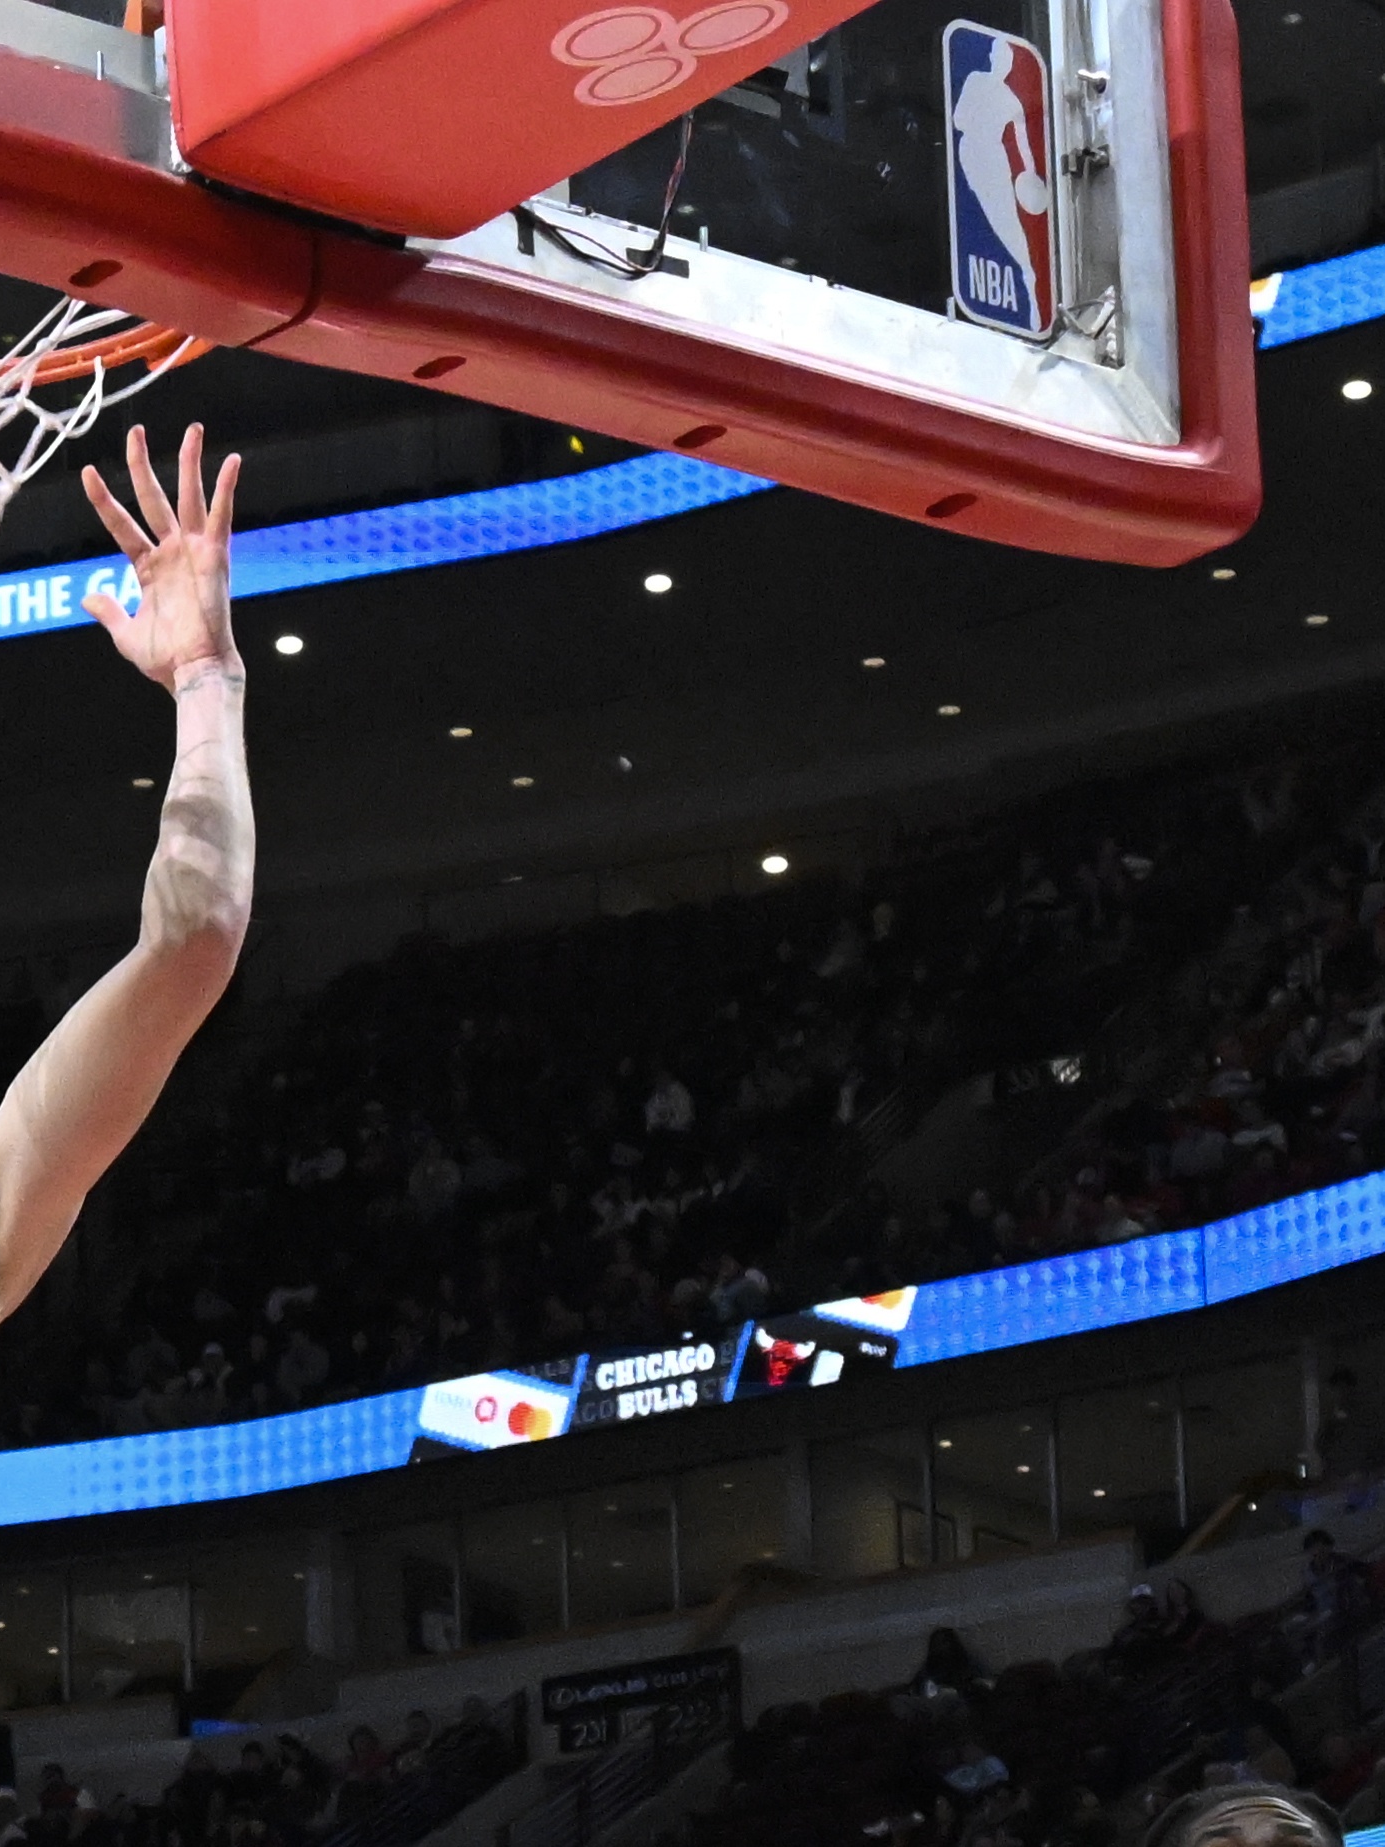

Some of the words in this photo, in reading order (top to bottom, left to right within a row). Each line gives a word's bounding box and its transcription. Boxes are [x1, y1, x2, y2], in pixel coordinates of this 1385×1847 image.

[968, 253, 1018, 312] NBA
[85, 563, 143, 607] GA
[595, 1343, 715, 1391] CHICAGO
[617, 1379, 697, 1419] BULLS
